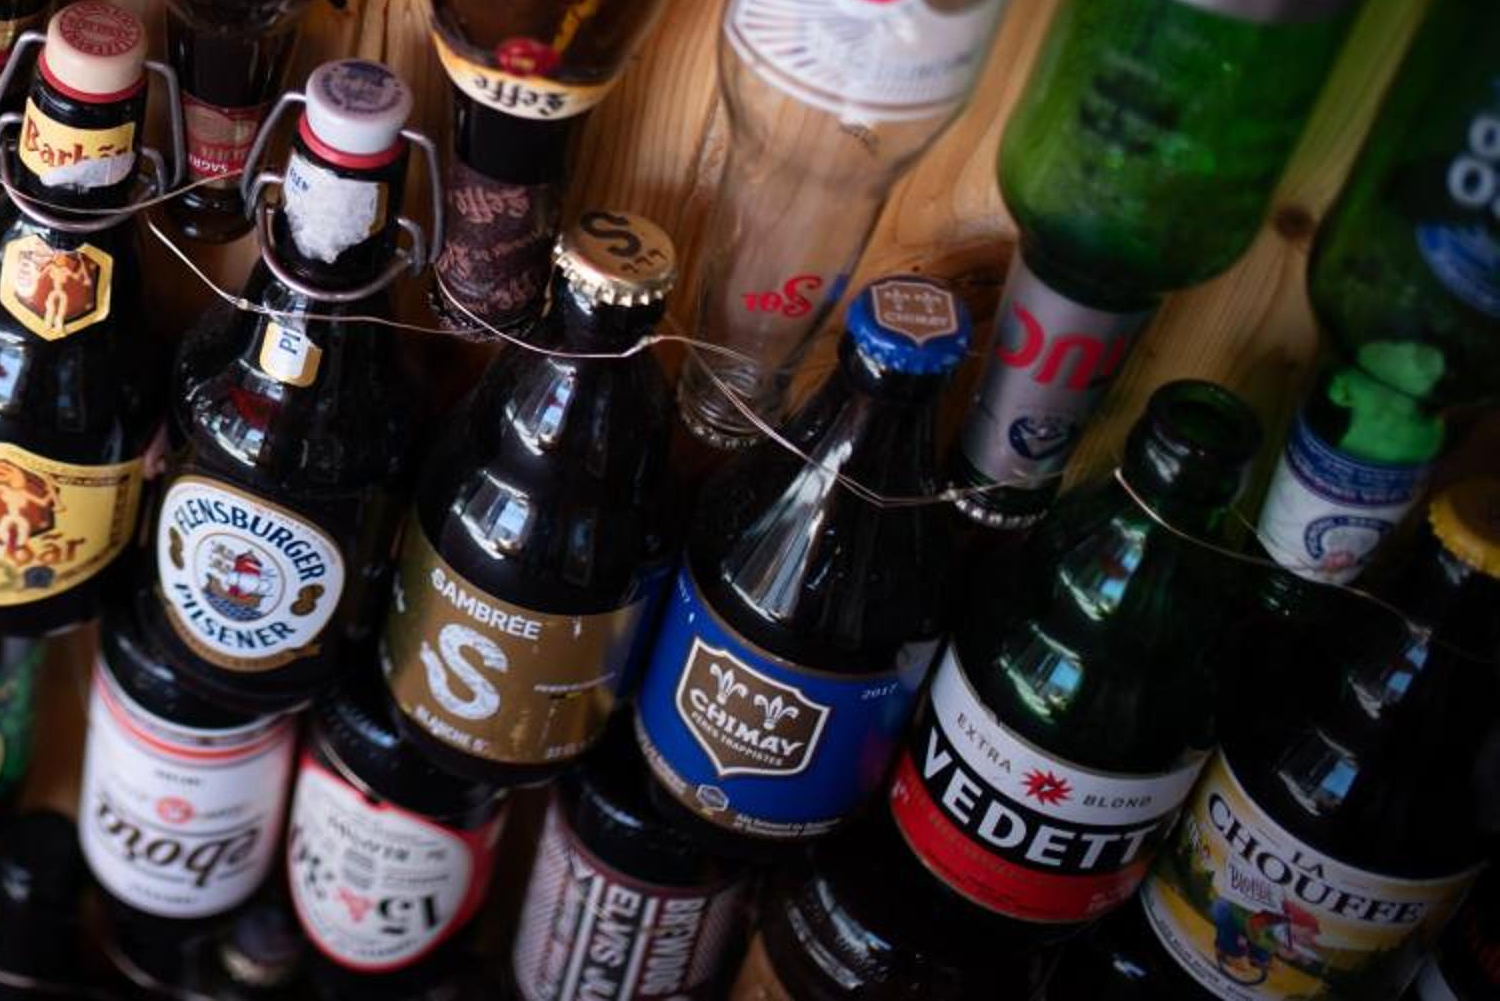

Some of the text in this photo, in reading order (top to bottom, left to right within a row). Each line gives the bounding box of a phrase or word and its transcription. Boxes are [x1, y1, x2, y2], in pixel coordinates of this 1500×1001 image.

[173, 495, 328, 585] FLENSBURGER
[173, 580, 297, 651] PILSENER
[428, 565, 544, 642] SAMBRÉE
[418, 623, 510, 722] S
[689, 687, 805, 757] CHIMAY
[955, 710, 1153, 810] EXTRA BLOND
[1206, 790, 1426, 925] CHOUFFE
[1290, 849, 1327, 879] LA
